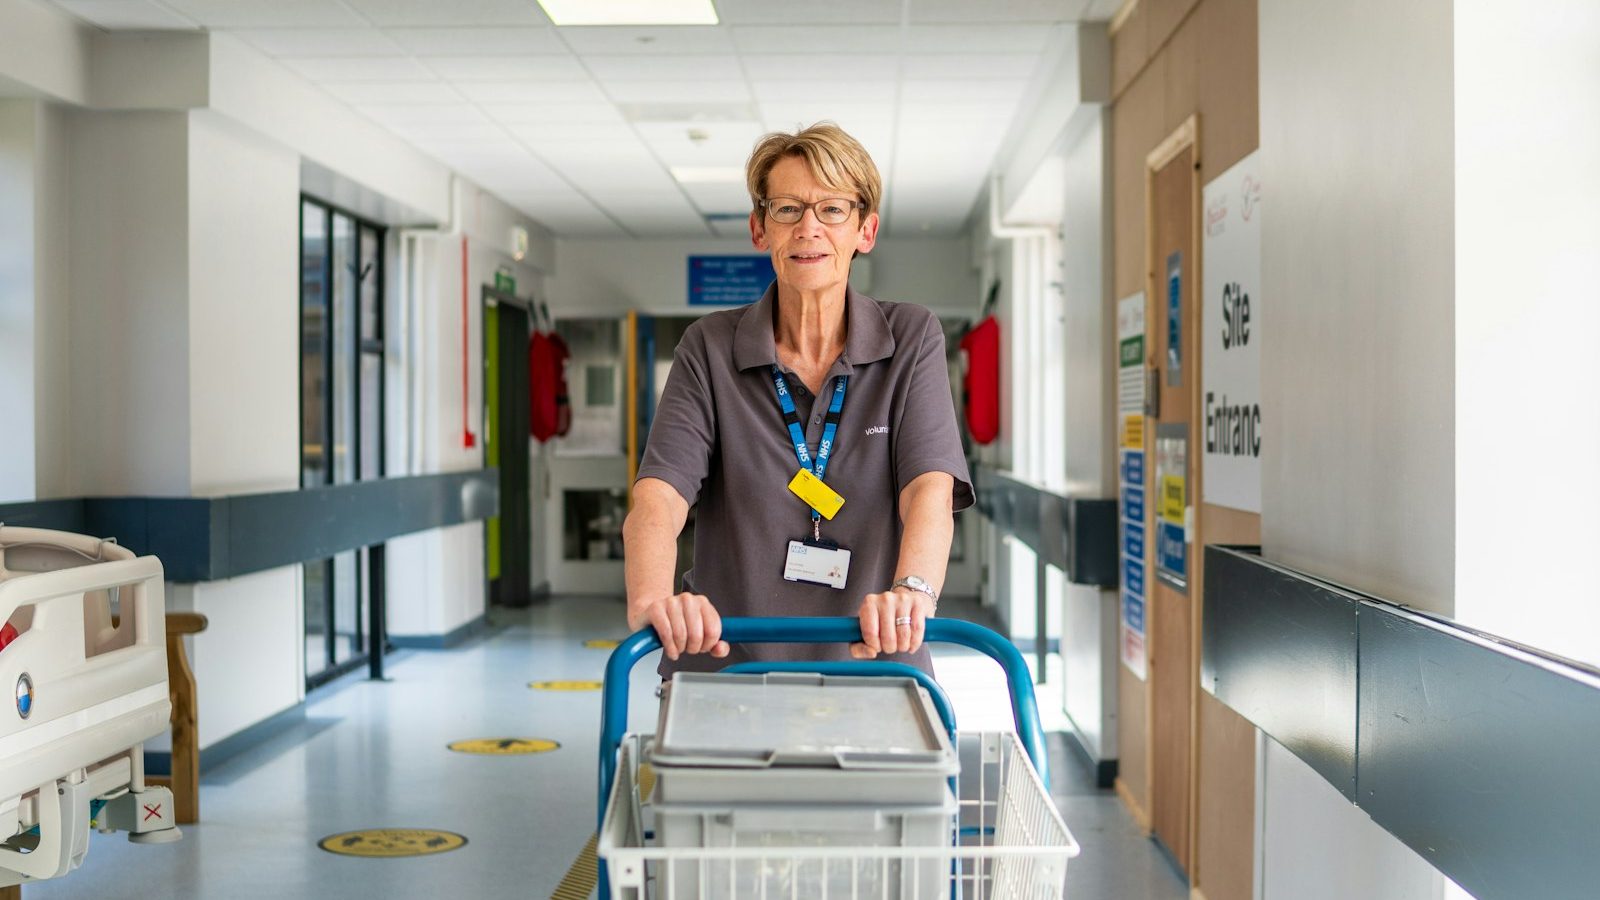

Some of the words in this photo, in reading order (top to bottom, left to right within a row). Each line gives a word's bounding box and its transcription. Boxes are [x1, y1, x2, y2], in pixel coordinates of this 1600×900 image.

[1222, 282, 1250, 350] Site
[775, 378, 787, 395] NHS
[1206, 392, 1260, 458] Entranc
[797, 443, 809, 462] NHS
[819, 439, 830, 460] NHS
